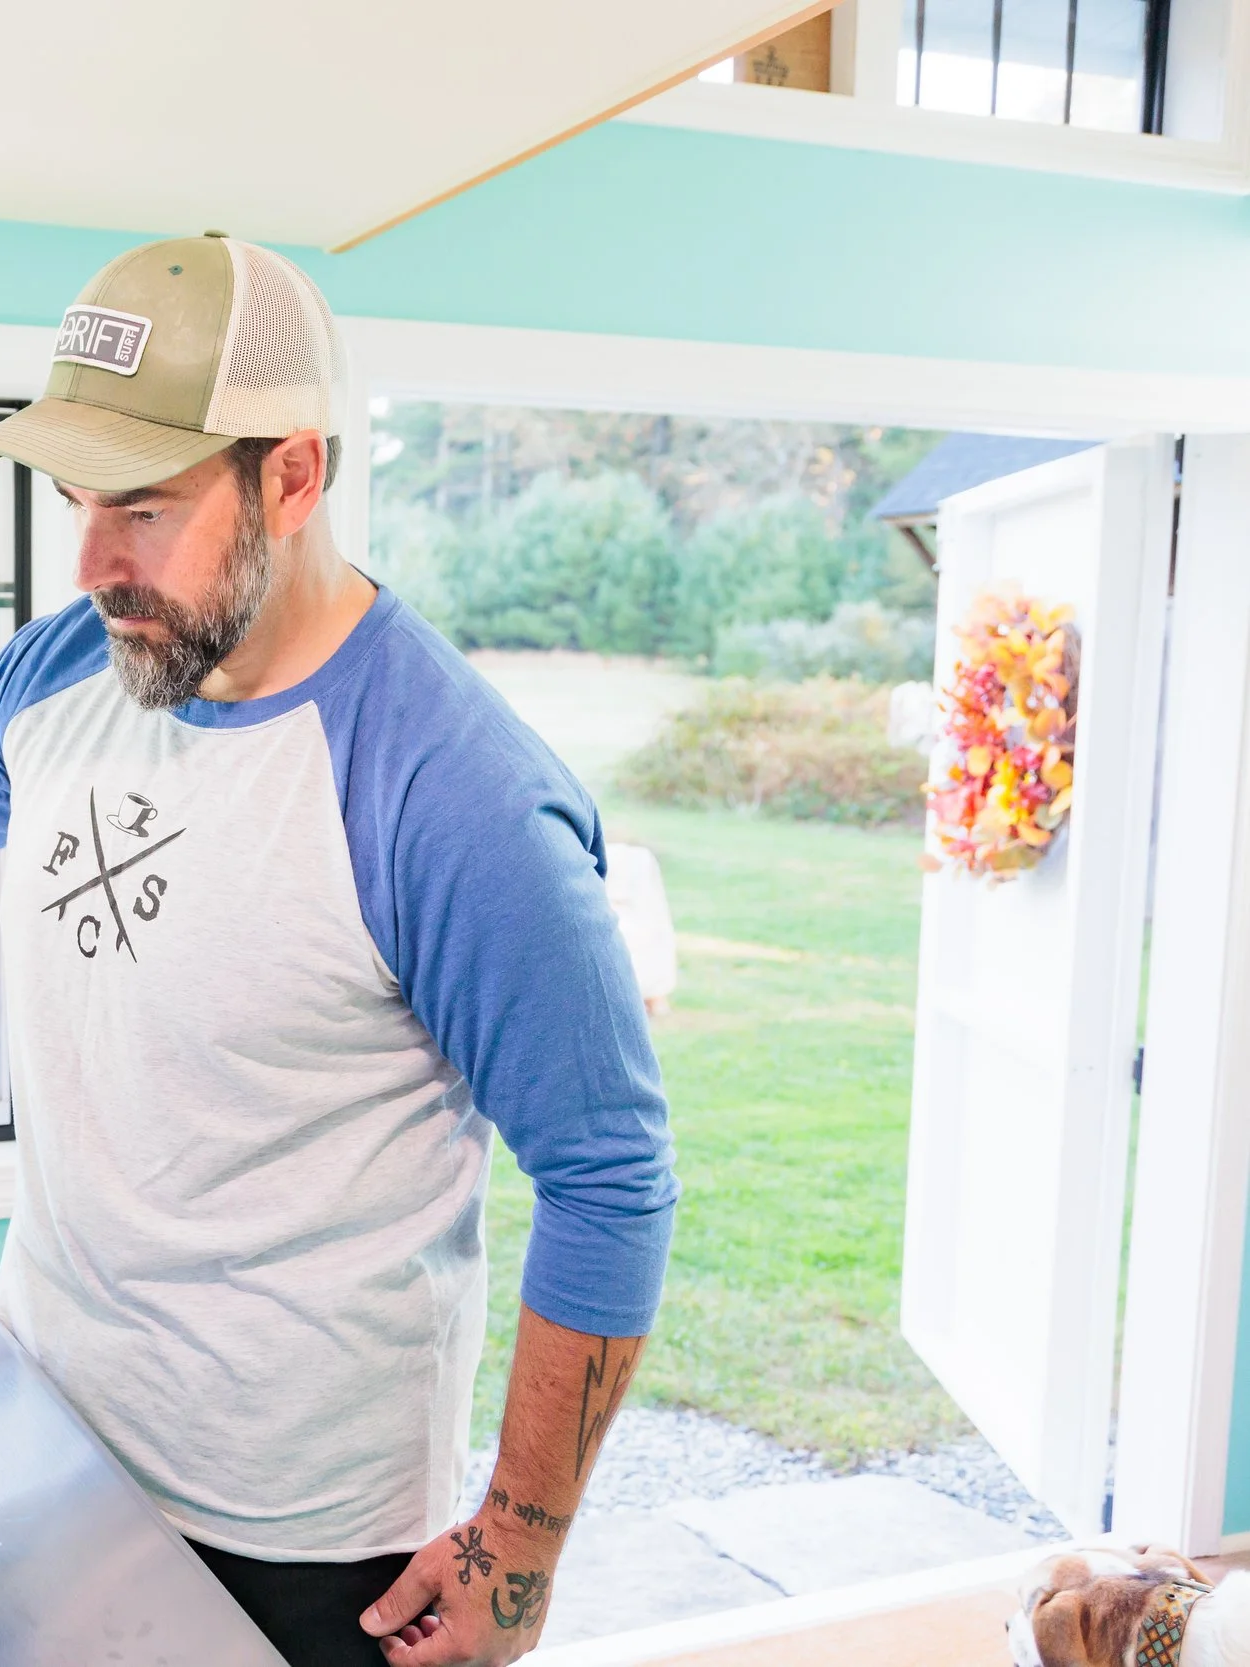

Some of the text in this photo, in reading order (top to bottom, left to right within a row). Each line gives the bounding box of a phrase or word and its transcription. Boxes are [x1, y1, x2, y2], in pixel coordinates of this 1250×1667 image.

[119, 329, 139, 362] SURF
[42, 831, 81, 876] F
[132, 873, 168, 922] S
[76, 914, 102, 959] C
